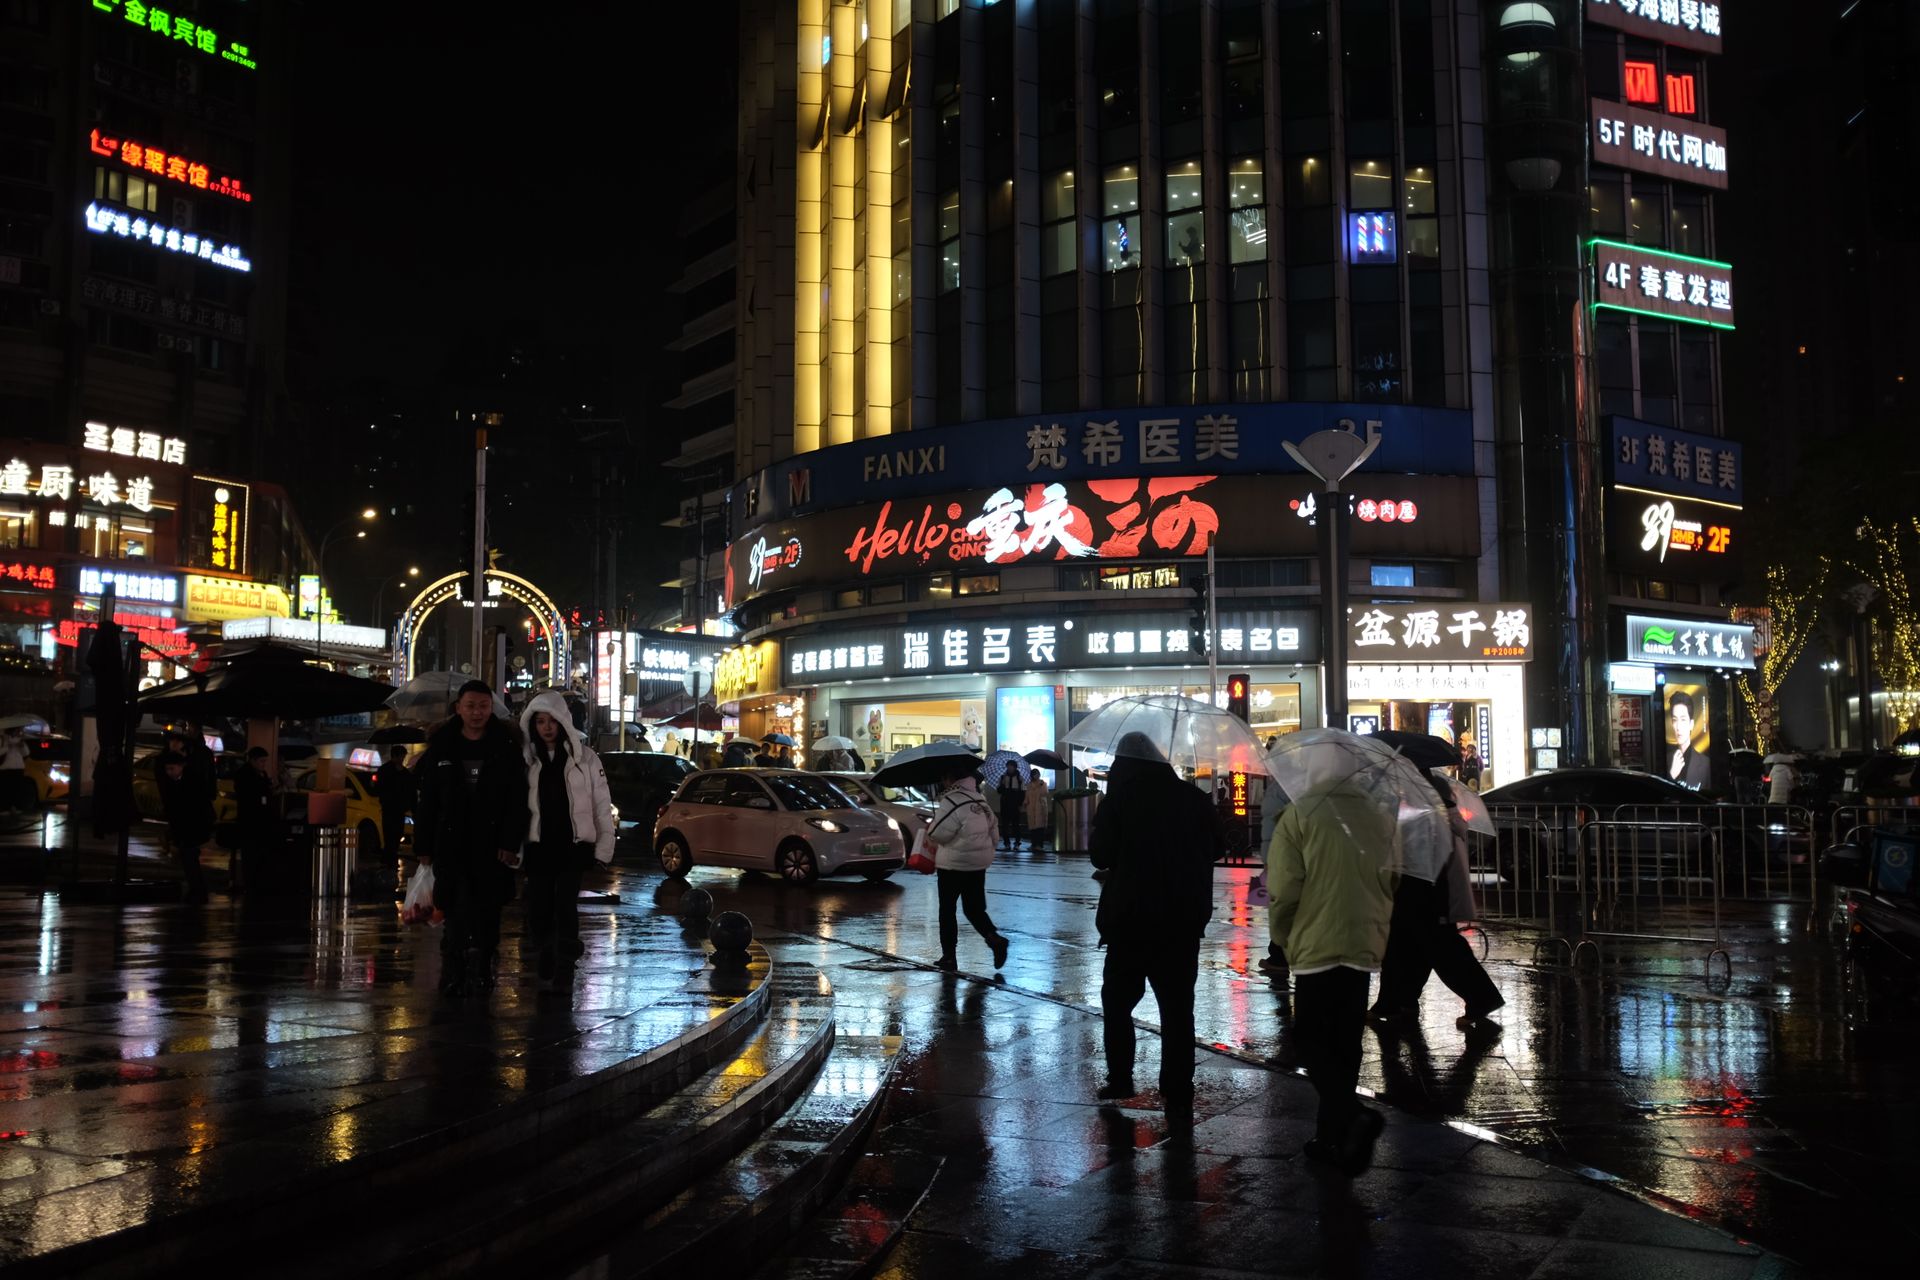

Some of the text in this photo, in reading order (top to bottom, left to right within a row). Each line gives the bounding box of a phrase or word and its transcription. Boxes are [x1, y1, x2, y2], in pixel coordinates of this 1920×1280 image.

[124, 0, 217, 54] 金枫宾馆
[121, 141, 209, 189] 缘聚宾馆
[1599, 118, 1727, 172] 5F 时代网咖
[1605, 262, 1732, 311] 4F 春意发型
[83, 422, 186, 465] 圣堡酒店
[864, 445, 945, 482] FANXI
[1026, 413, 1239, 471] 梵希医美
[1621, 434, 1737, 490] 3F 梵希医美
[845, 500, 948, 574] Hello
[966, 482, 1102, 563] 重庆
[1671, 528, 1695, 545] RMB
[1707, 526, 1731, 553] 2F
[784, 544, 798, 564] 2F
[903, 624, 1057, 669] 瑞佳名表
[1354, 608, 1530, 648] 盆源干锅
